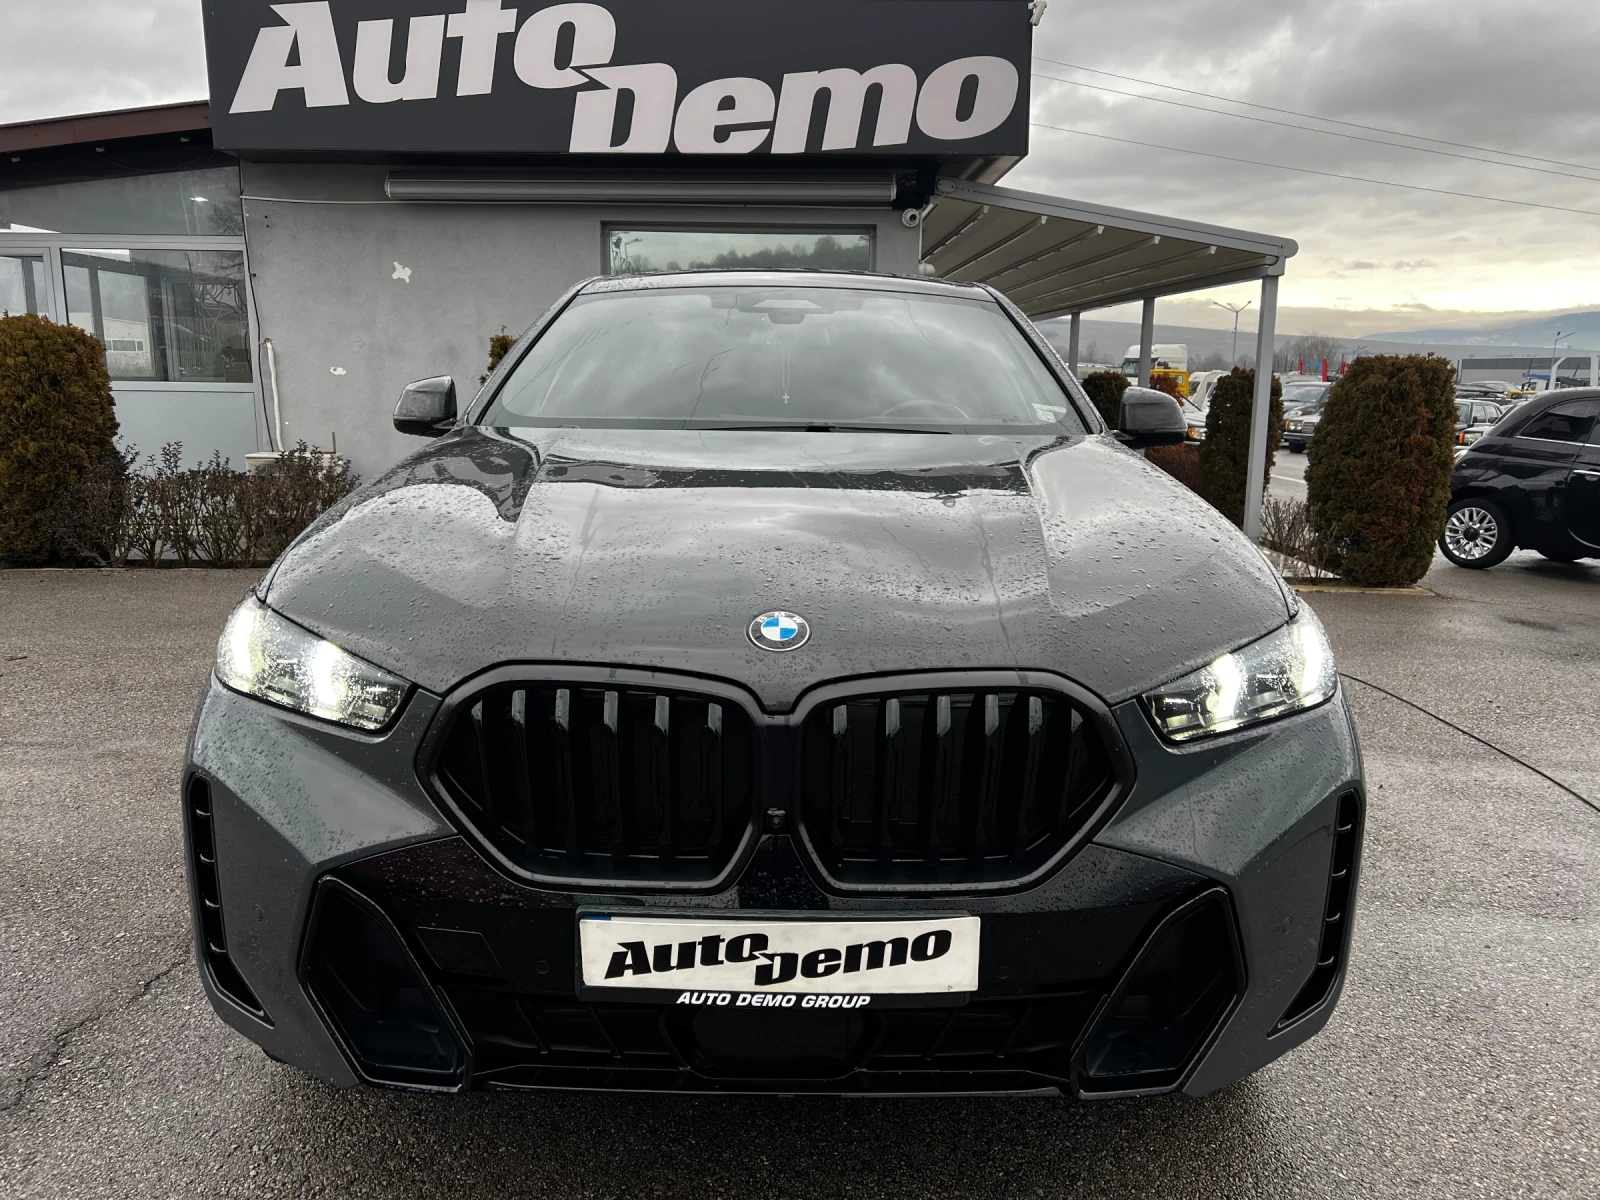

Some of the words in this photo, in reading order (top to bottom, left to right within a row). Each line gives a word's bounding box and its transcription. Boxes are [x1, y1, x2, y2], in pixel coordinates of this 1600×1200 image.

[229, 0, 616, 113] Auto
[569, 55, 1019, 154] Demo
[756, 611, 804, 624] BMW
[604, 933, 768, 979] Auto
[754, 929, 952, 986] Demo
[676, 991, 731, 1006] AUTO
[736, 993, 796, 1007] DEMO
[801, 995, 871, 1009] GROUP
